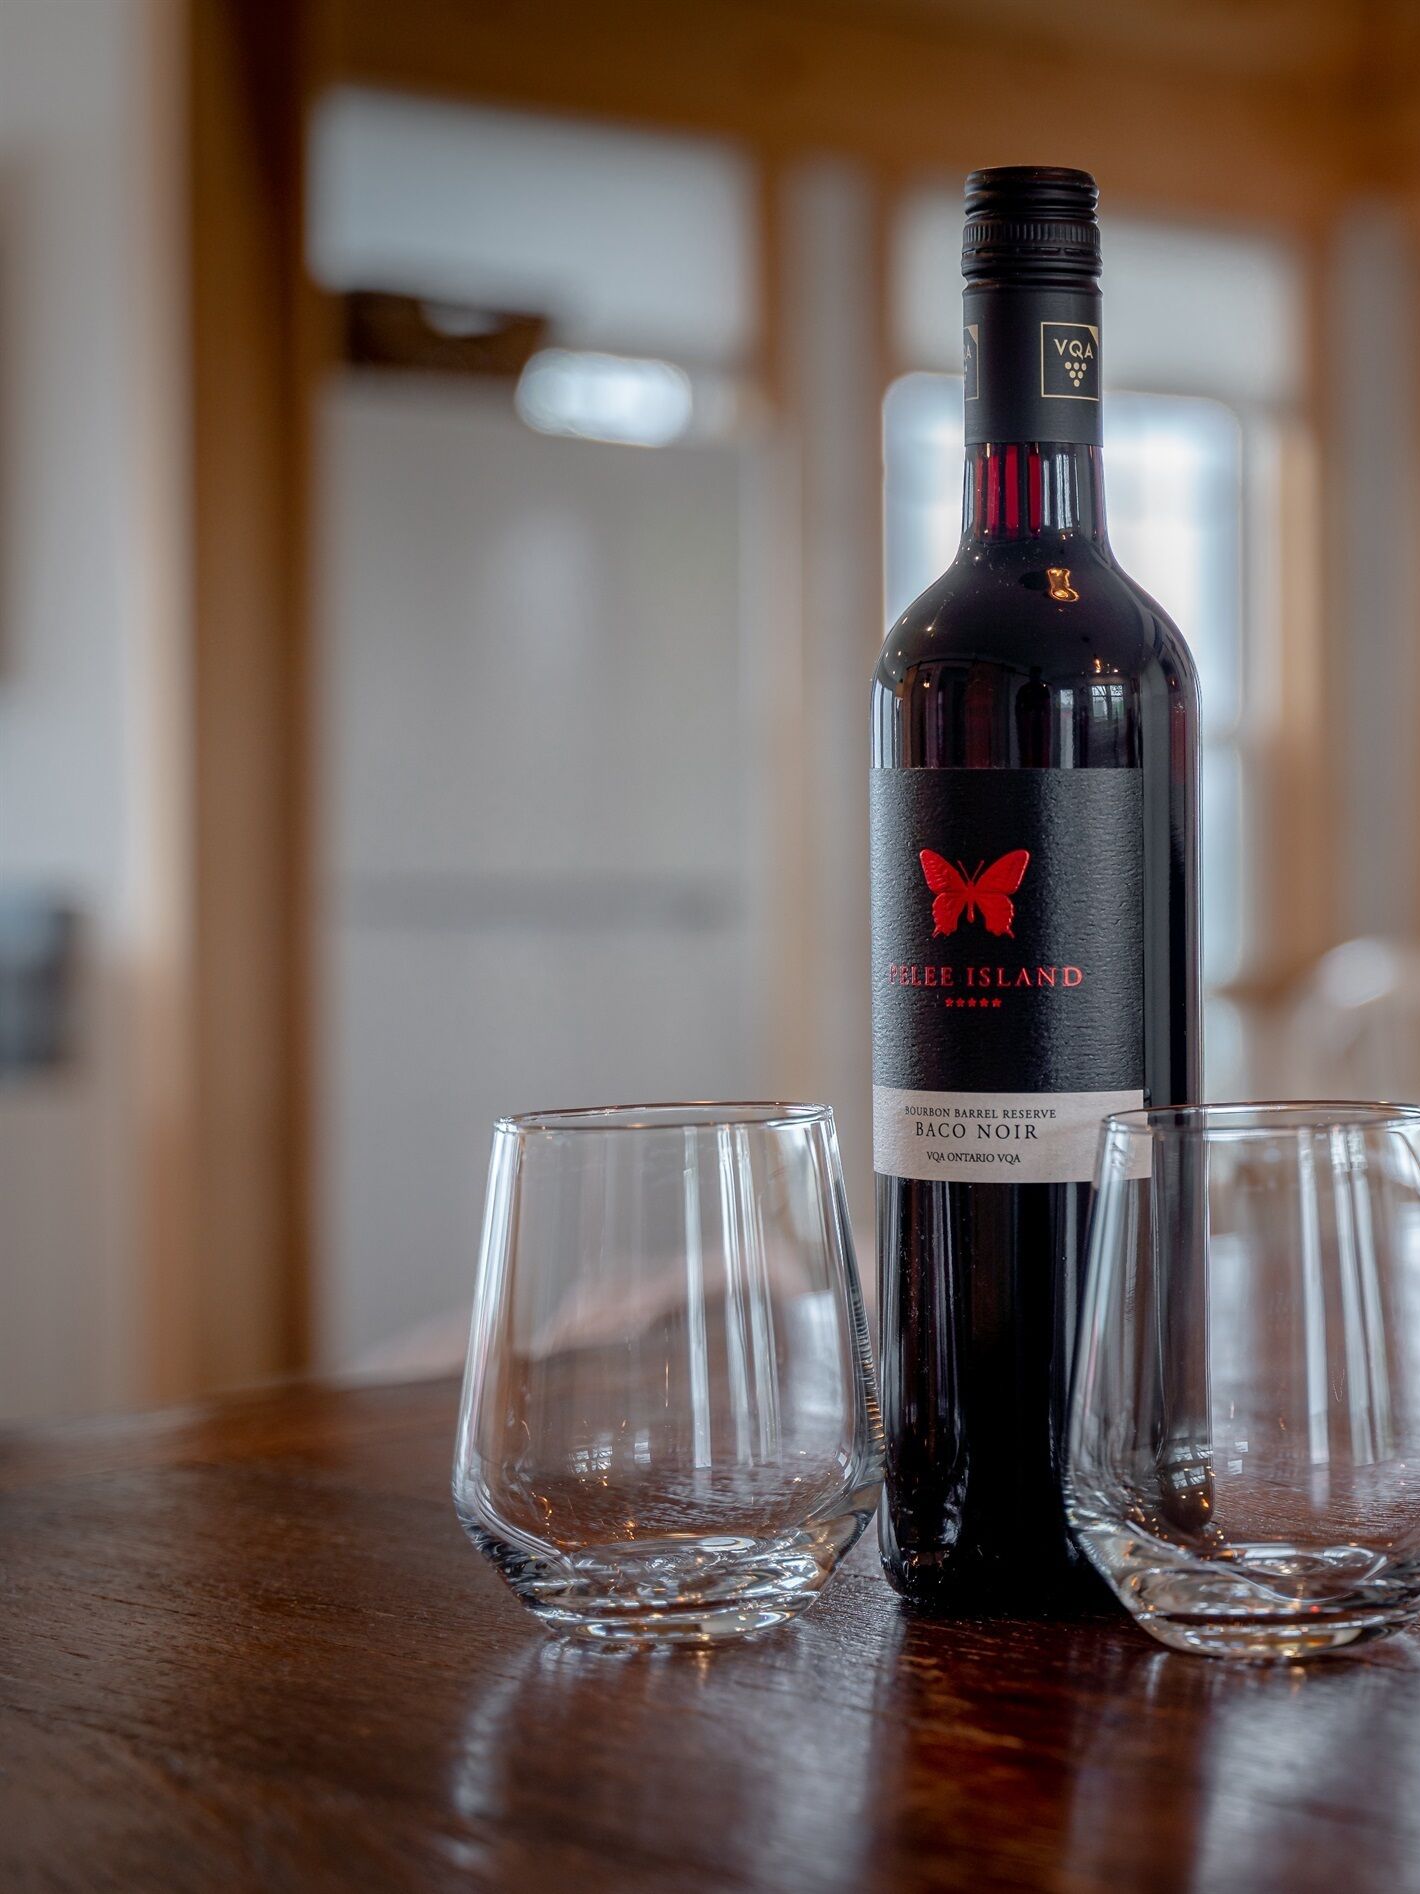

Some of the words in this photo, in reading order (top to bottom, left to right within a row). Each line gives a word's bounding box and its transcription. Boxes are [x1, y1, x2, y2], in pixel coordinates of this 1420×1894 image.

[1054, 339, 1094, 360] VQA
[889, 963, 955, 987] PELEE
[966, 966, 1084, 988] ISLAND
[905, 1106, 951, 1118] BOURBON
[954, 1109, 999, 1119] BARREL
[1003, 1109, 1057, 1119] RESERVE
[916, 1121, 967, 1139] BACO
[977, 1124, 1039, 1140] NOIR
[926, 1151, 946, 1164] VQA
[947, 1152, 996, 1163] ONTARIO
[997, 1153, 1022, 1166] VQA
